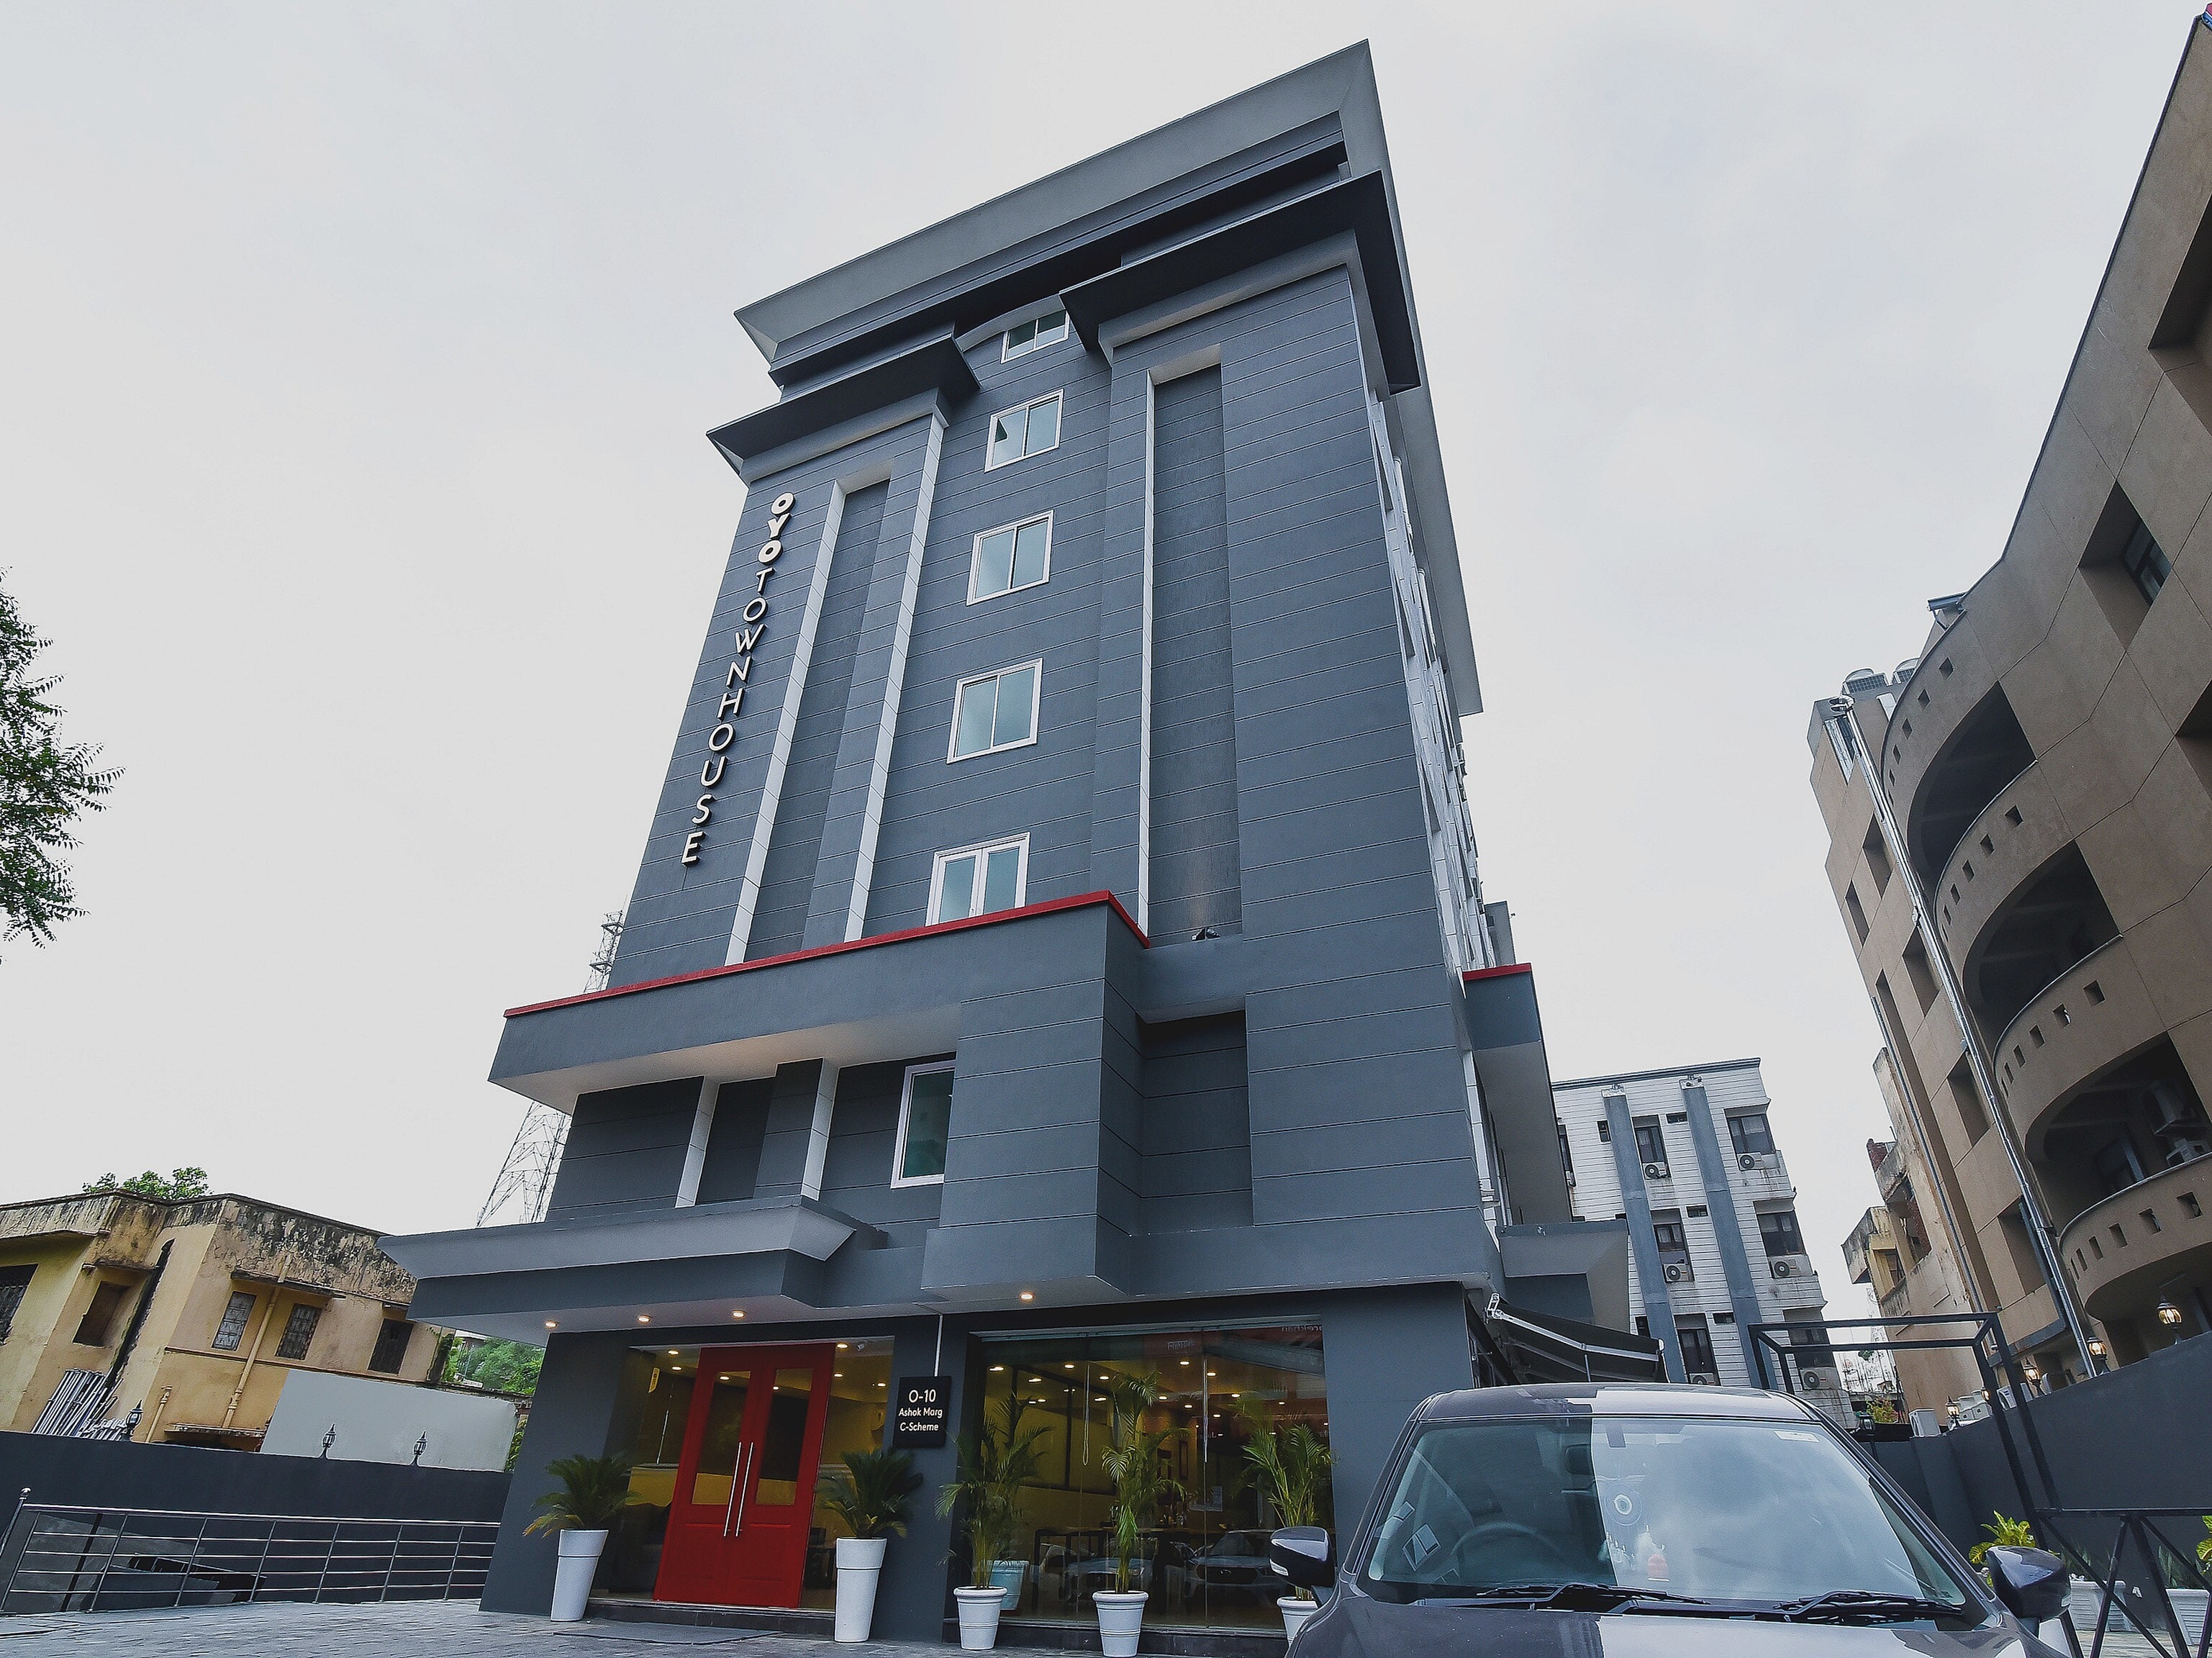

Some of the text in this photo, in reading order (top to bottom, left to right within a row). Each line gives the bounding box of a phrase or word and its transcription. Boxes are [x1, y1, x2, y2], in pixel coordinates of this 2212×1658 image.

[681, 491, 795, 866] OYO TOWNHOUSE
[908, 1389, 936, 1403] O-10
[898, 1407, 943, 1419] Ashok Marg
[899, 1422, 939, 1431] C-Scheme
